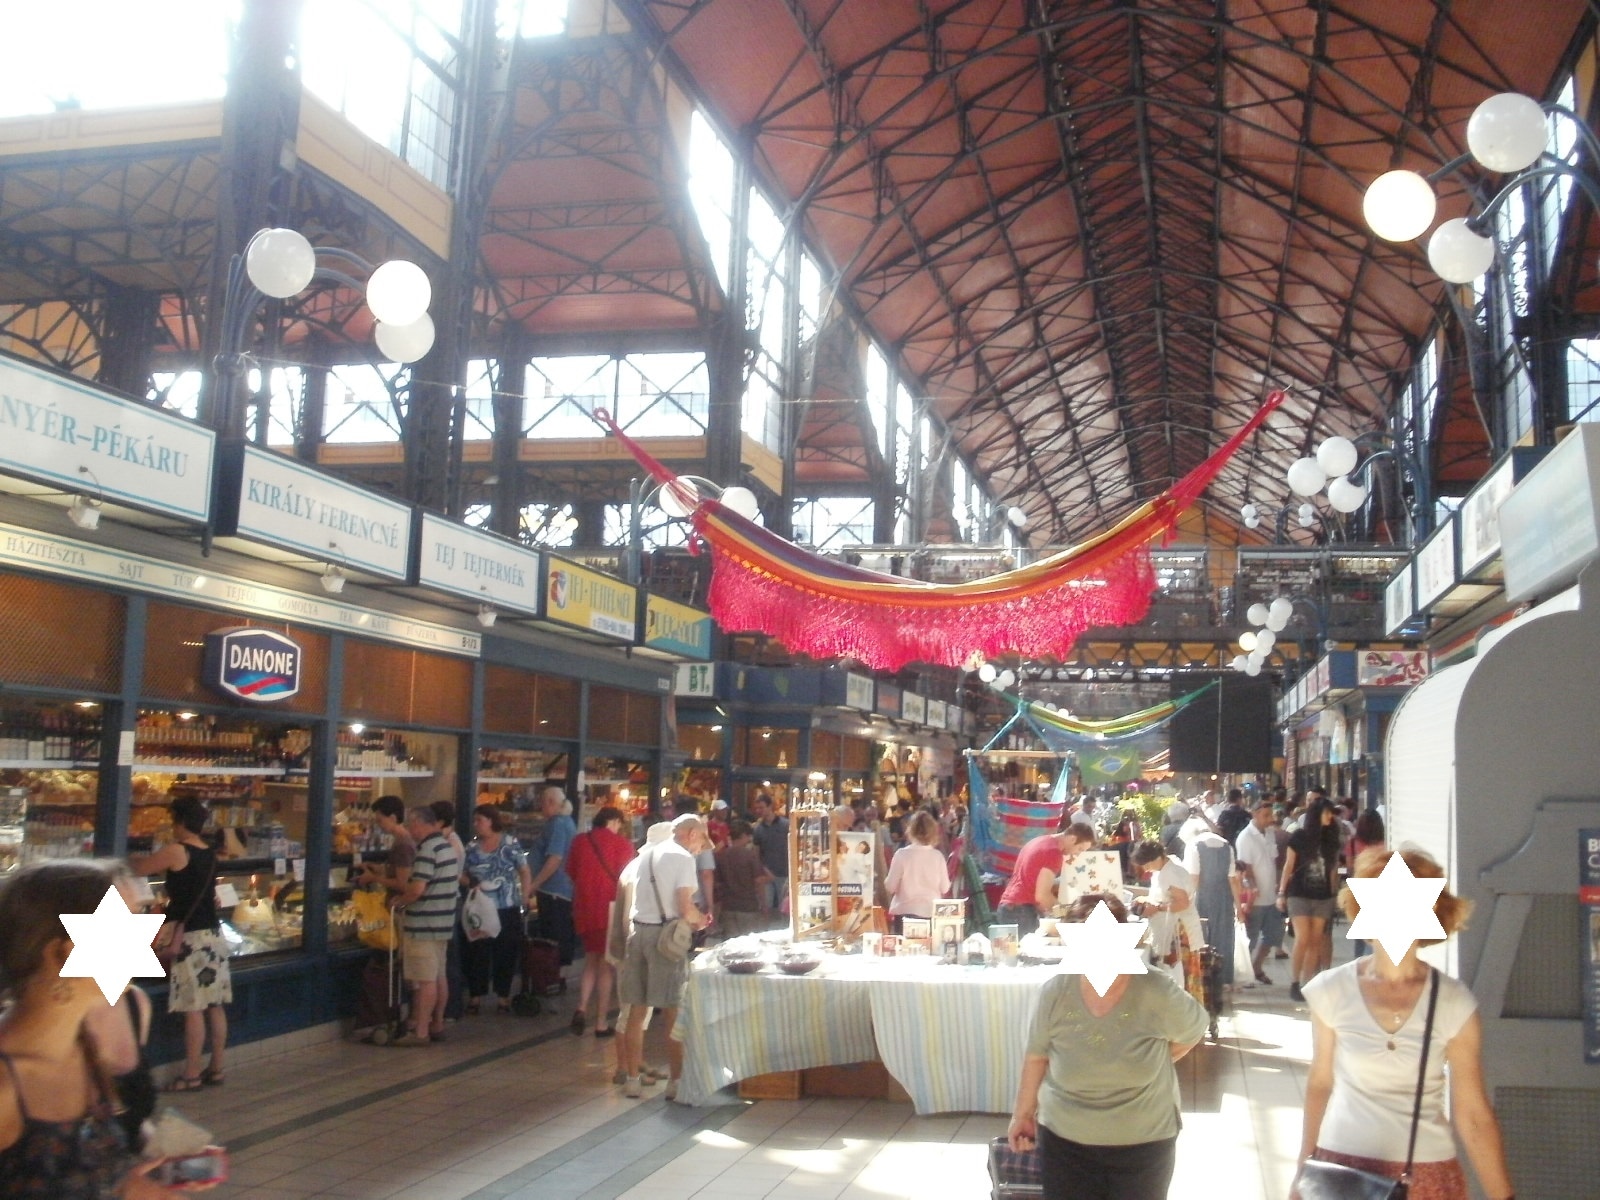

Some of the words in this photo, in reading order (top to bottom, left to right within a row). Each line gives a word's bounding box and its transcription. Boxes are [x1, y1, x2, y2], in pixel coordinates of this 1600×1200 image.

[247, 477, 316, 520] KIRÁLY
[319, 502, 399, 549] FERENCNÉ
[6, 536, 87, 566] HÁZITÉSZTA
[118, 561, 145, 579] SAJT
[172, 571, 205, 590] TÚR
[435, 542, 457, 577] TEJ
[463, 551, 526, 588] TEJTERMÉK
[230, 644, 294, 675] DANONE
[812, 885, 861, 894] TRAMNTINA
